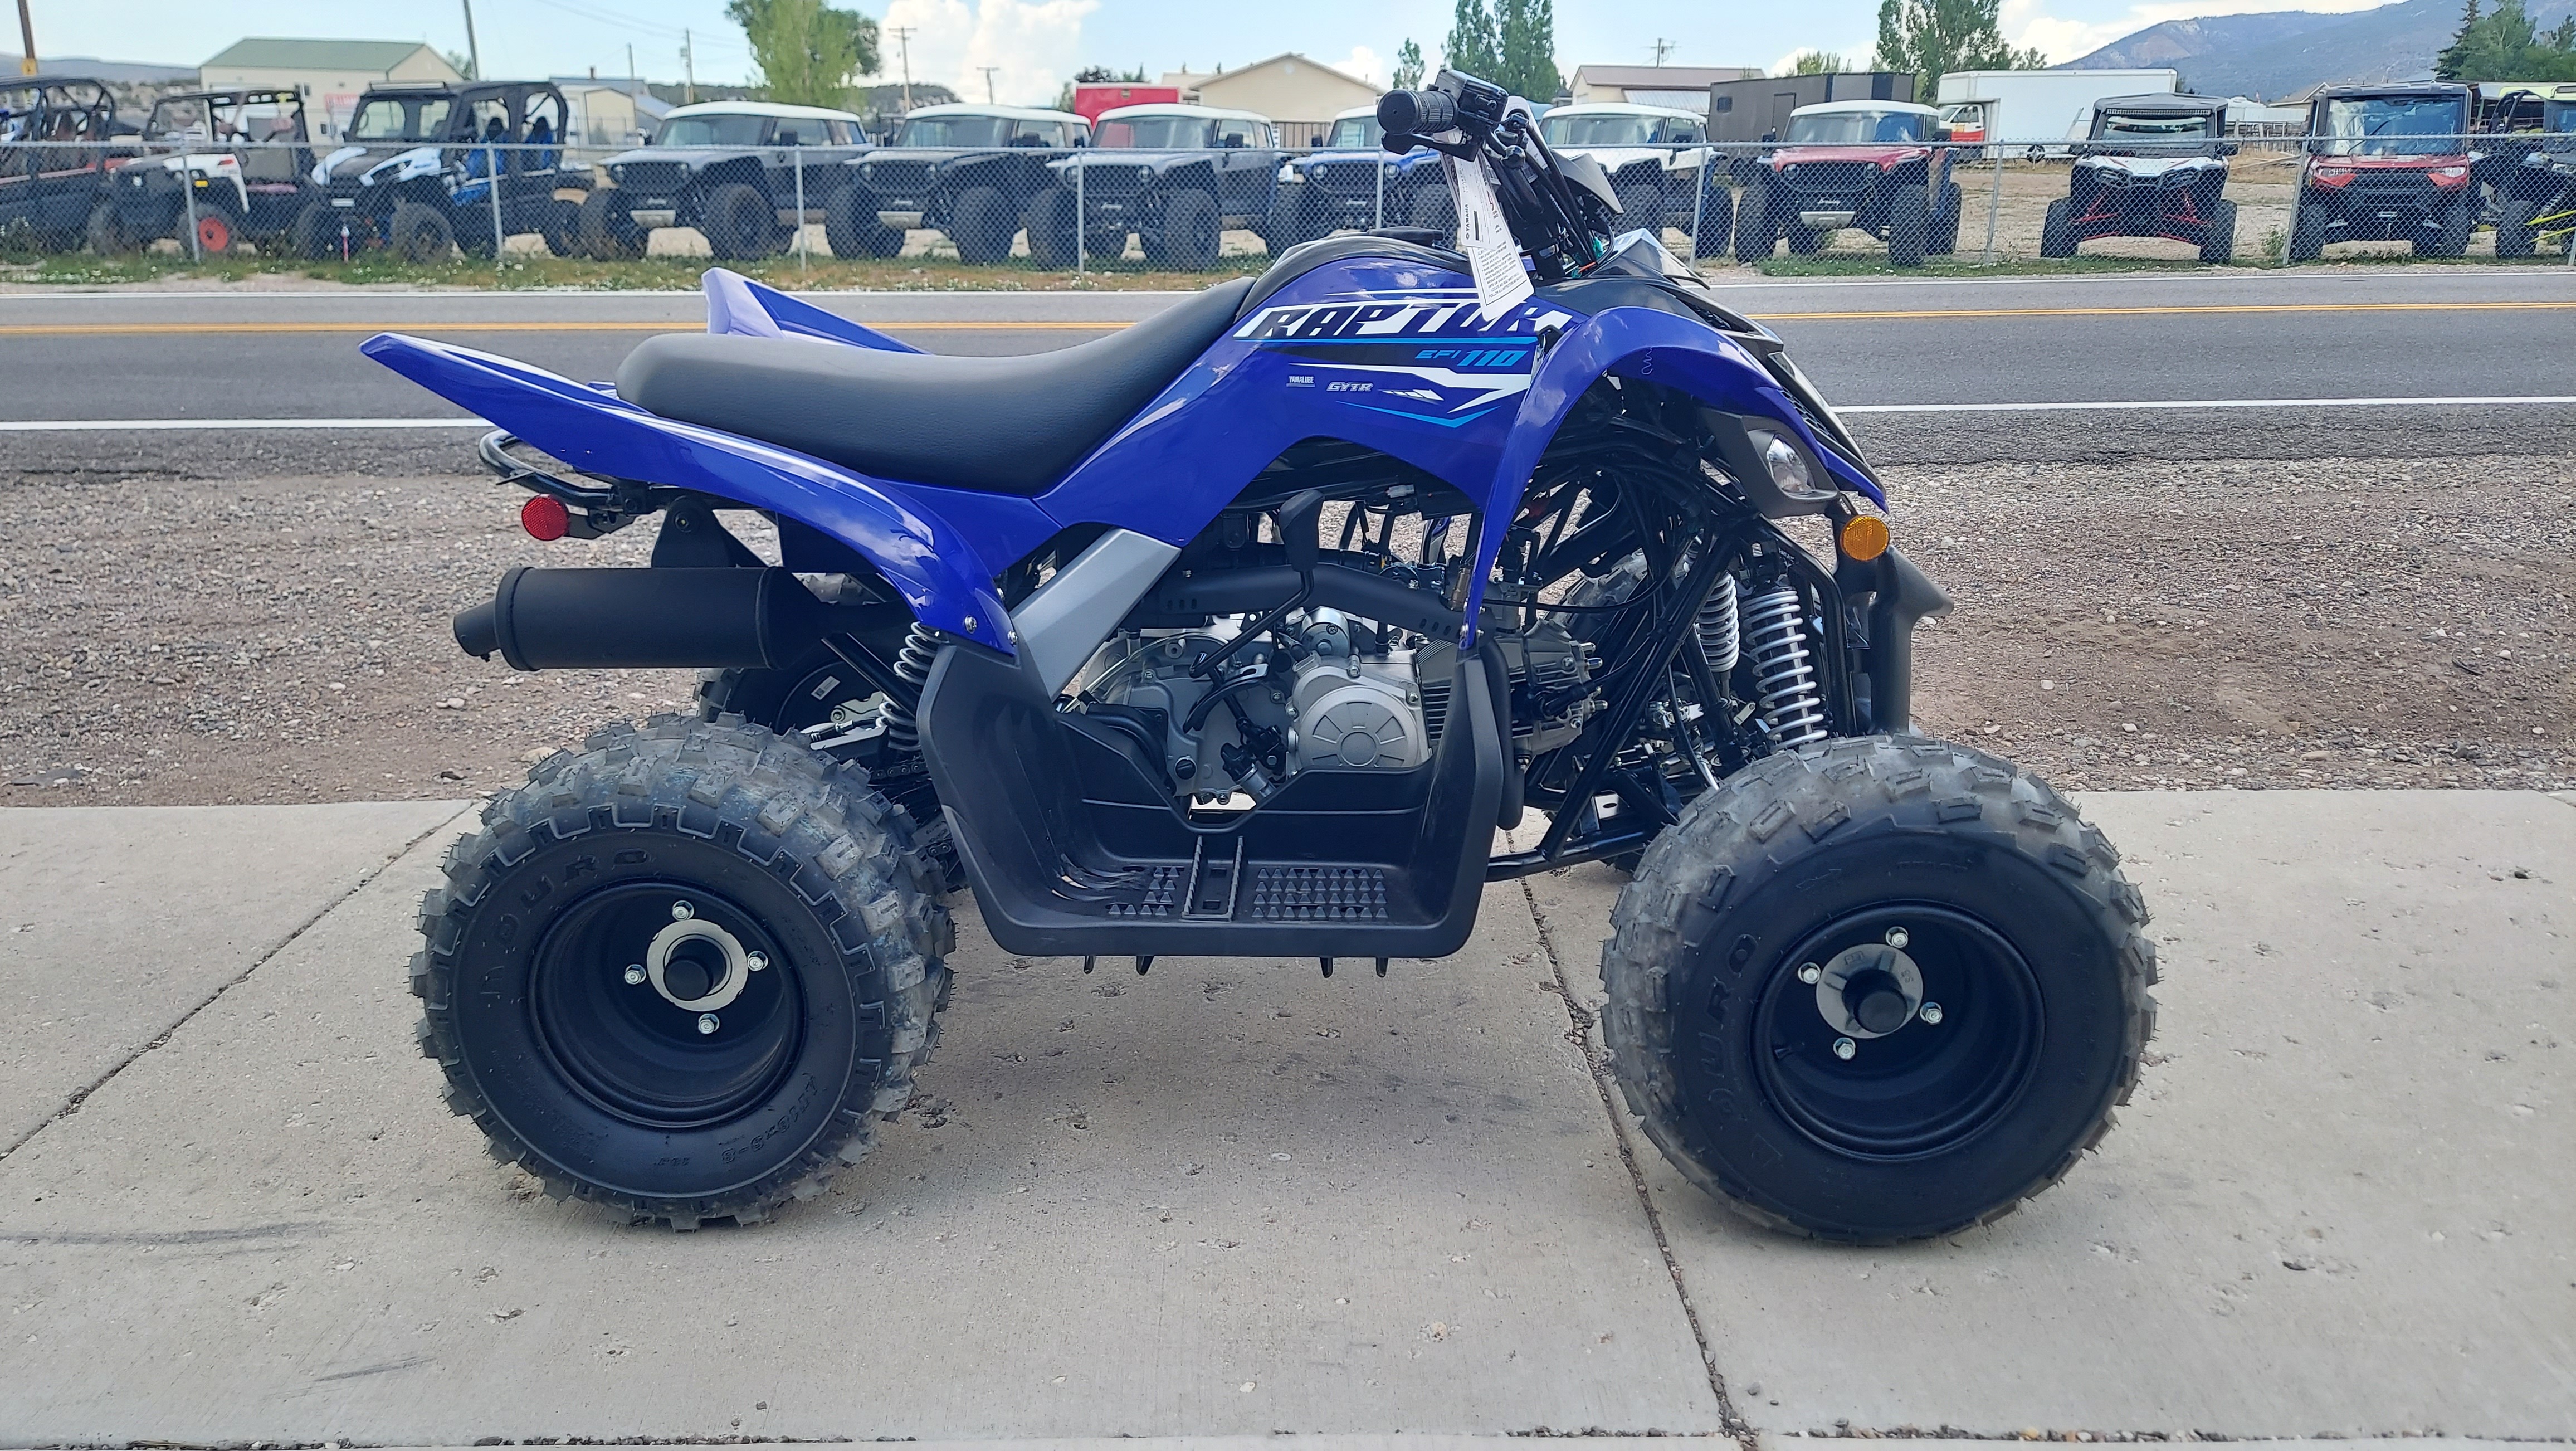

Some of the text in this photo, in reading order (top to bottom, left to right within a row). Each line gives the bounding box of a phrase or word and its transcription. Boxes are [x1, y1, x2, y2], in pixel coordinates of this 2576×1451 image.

[1414, 349, 1529, 367] EFI 110
[1326, 382, 1374, 392] GYTR
